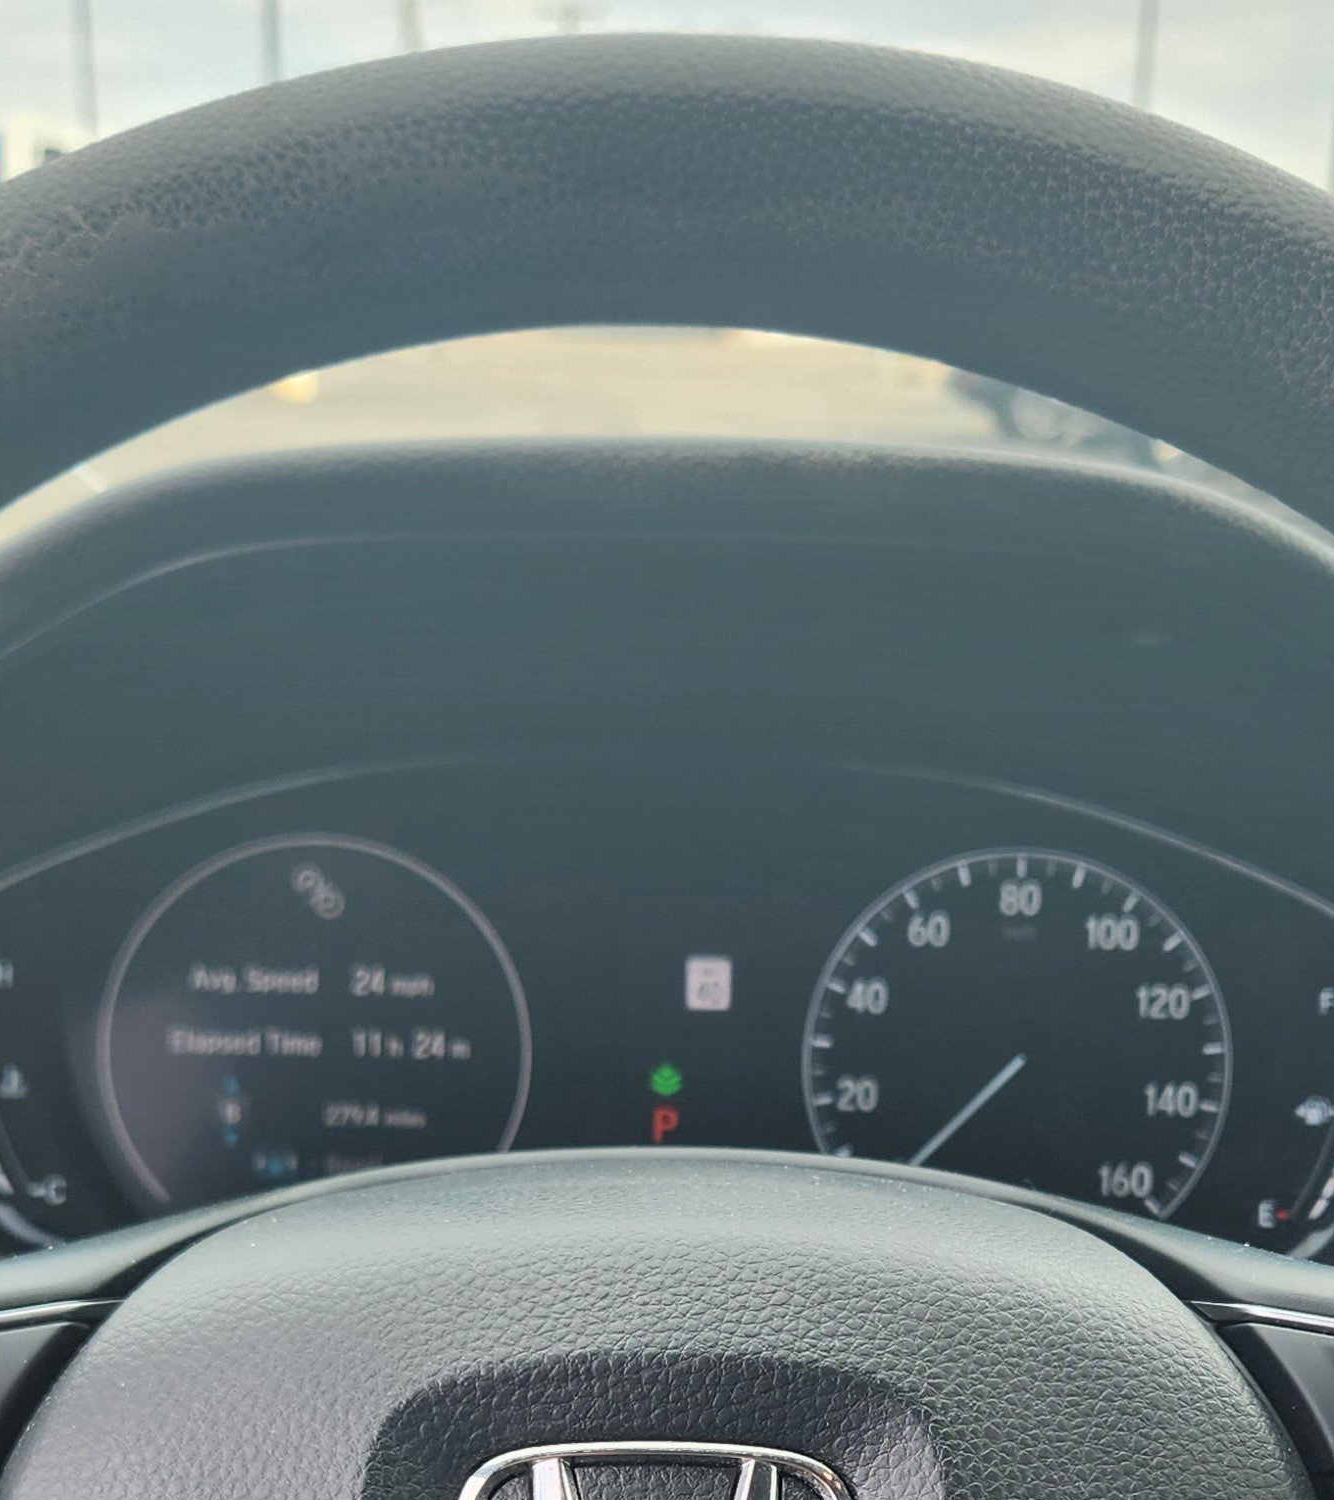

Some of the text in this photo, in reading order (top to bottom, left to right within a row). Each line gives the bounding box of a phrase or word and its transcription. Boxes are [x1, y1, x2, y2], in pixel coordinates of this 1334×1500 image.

[999, 883, 1043, 917] 80
[907, 916, 951, 949] 60
[1085, 917, 1139, 951] 100
[351, 964, 385, 997] 24
[846, 981, 889, 1014] 40
[1137, 986, 1191, 1019] 120
[267, 1025, 323, 1057] Time
[412, 1028, 445, 1060] 24
[836, 1079, 878, 1112] 20
[1144, 1083, 1199, 1117] 140
[652, 1108, 679, 1142] P
[1098, 1164, 1155, 1198] 160
[1258, 1200, 1276, 1228] E
